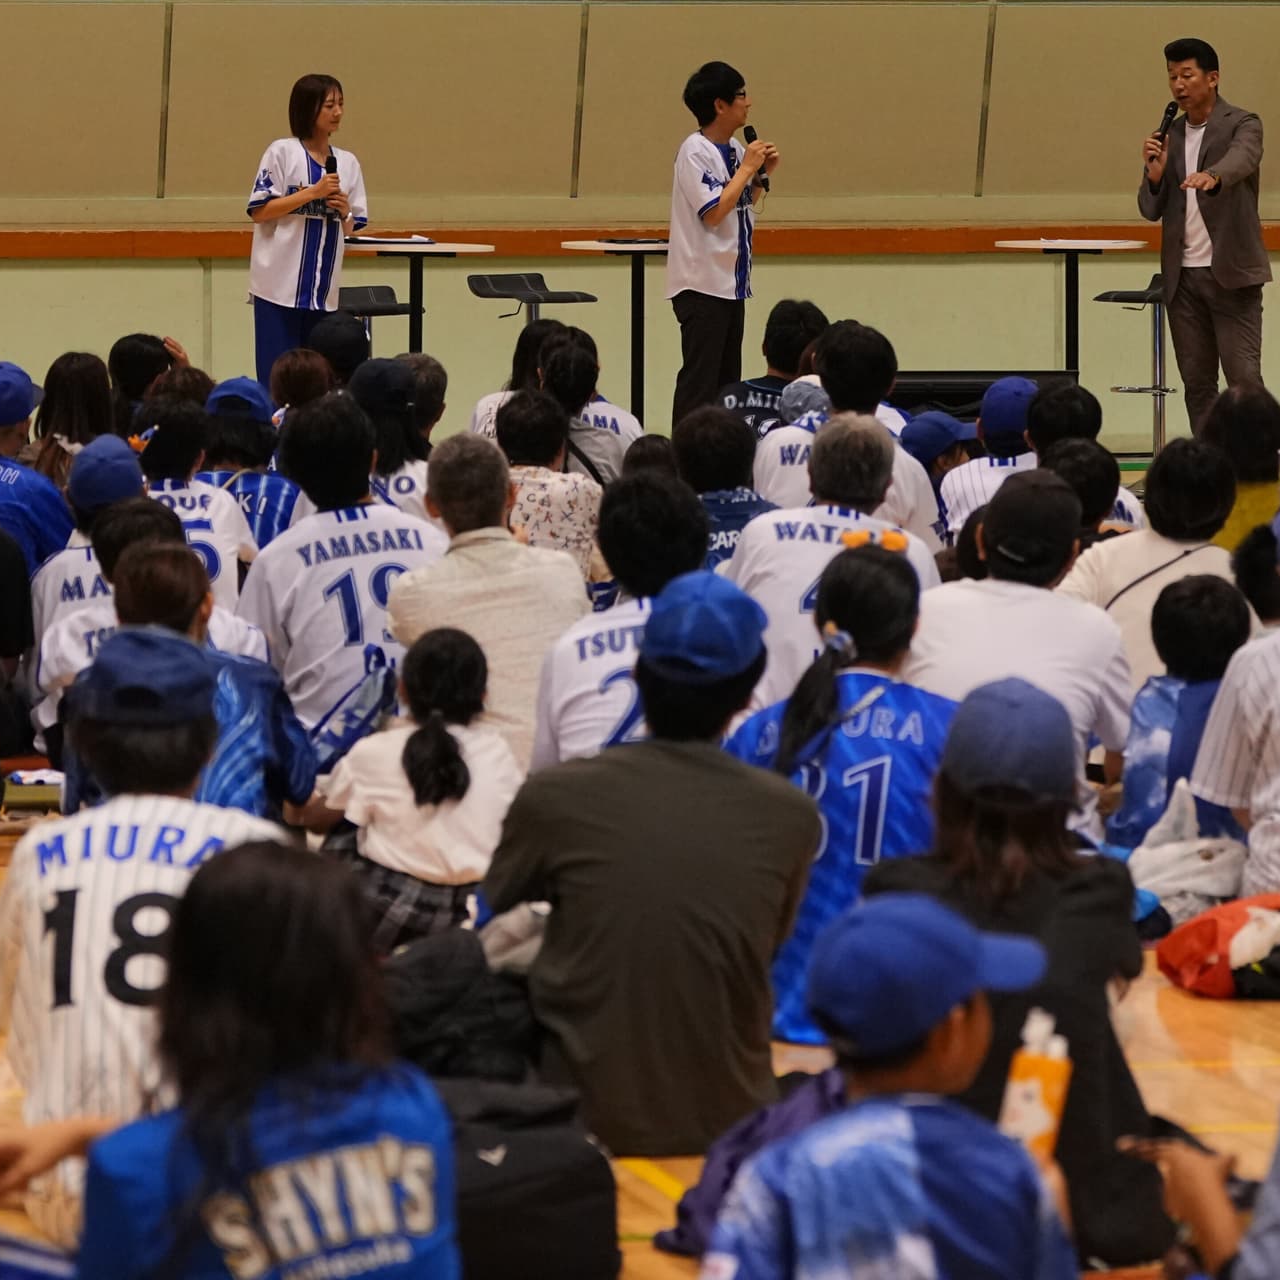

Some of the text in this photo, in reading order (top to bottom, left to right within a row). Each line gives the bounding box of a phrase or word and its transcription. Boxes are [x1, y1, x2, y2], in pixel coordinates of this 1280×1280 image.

[724, 391, 782, 411] D.MIU
[296, 528, 424, 568] YAMASAKI
[35, 823, 224, 876] MIURA
[42, 886, 176, 1009] 18
